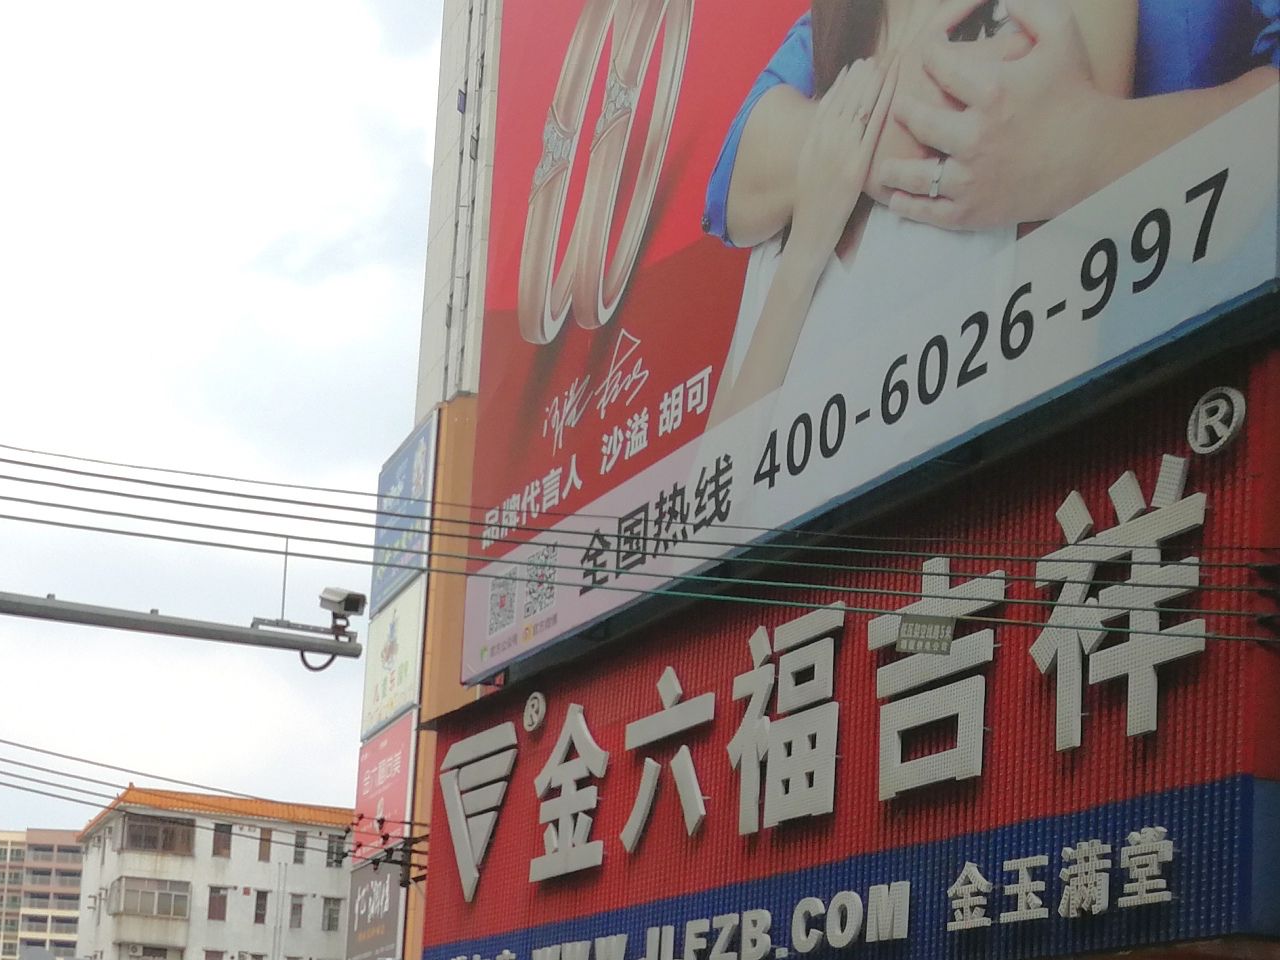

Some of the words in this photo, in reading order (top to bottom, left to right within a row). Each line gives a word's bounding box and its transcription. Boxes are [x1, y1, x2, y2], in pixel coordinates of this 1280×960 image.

[481, 453, 583, 550] 品牌代言人
[600, 406, 649, 475] 沙溢
[658, 365, 713, 437] 胡可
[579, 453, 734, 597] 全国热线
[752, 168, 1231, 490] 400-6026-997
[529, 453, 1208, 882] 金六福吉祥
[947, 825, 1176, 932] 金玉满堂
